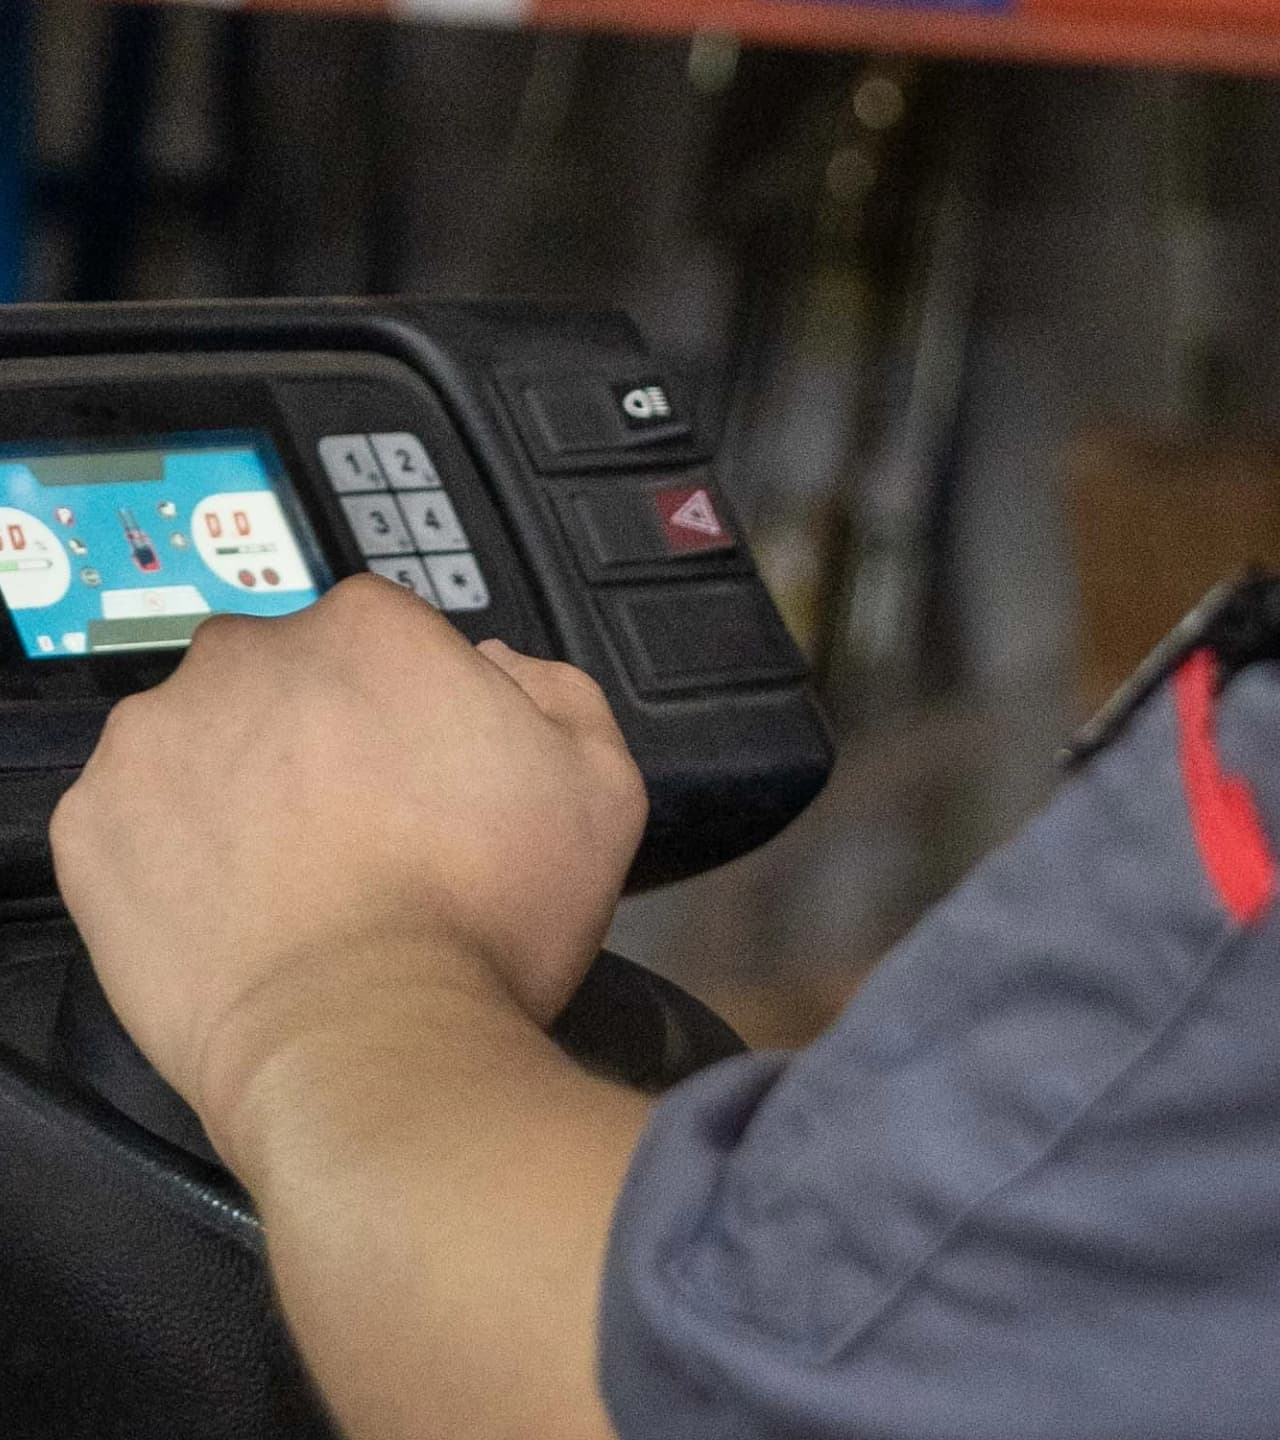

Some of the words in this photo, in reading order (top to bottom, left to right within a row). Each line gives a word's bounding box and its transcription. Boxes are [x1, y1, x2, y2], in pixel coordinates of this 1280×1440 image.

[345, 451, 361, 474] 1
[395, 449, 414, 472] 2
[371, 510, 391, 534] 3
[425, 507, 440, 530] 4
